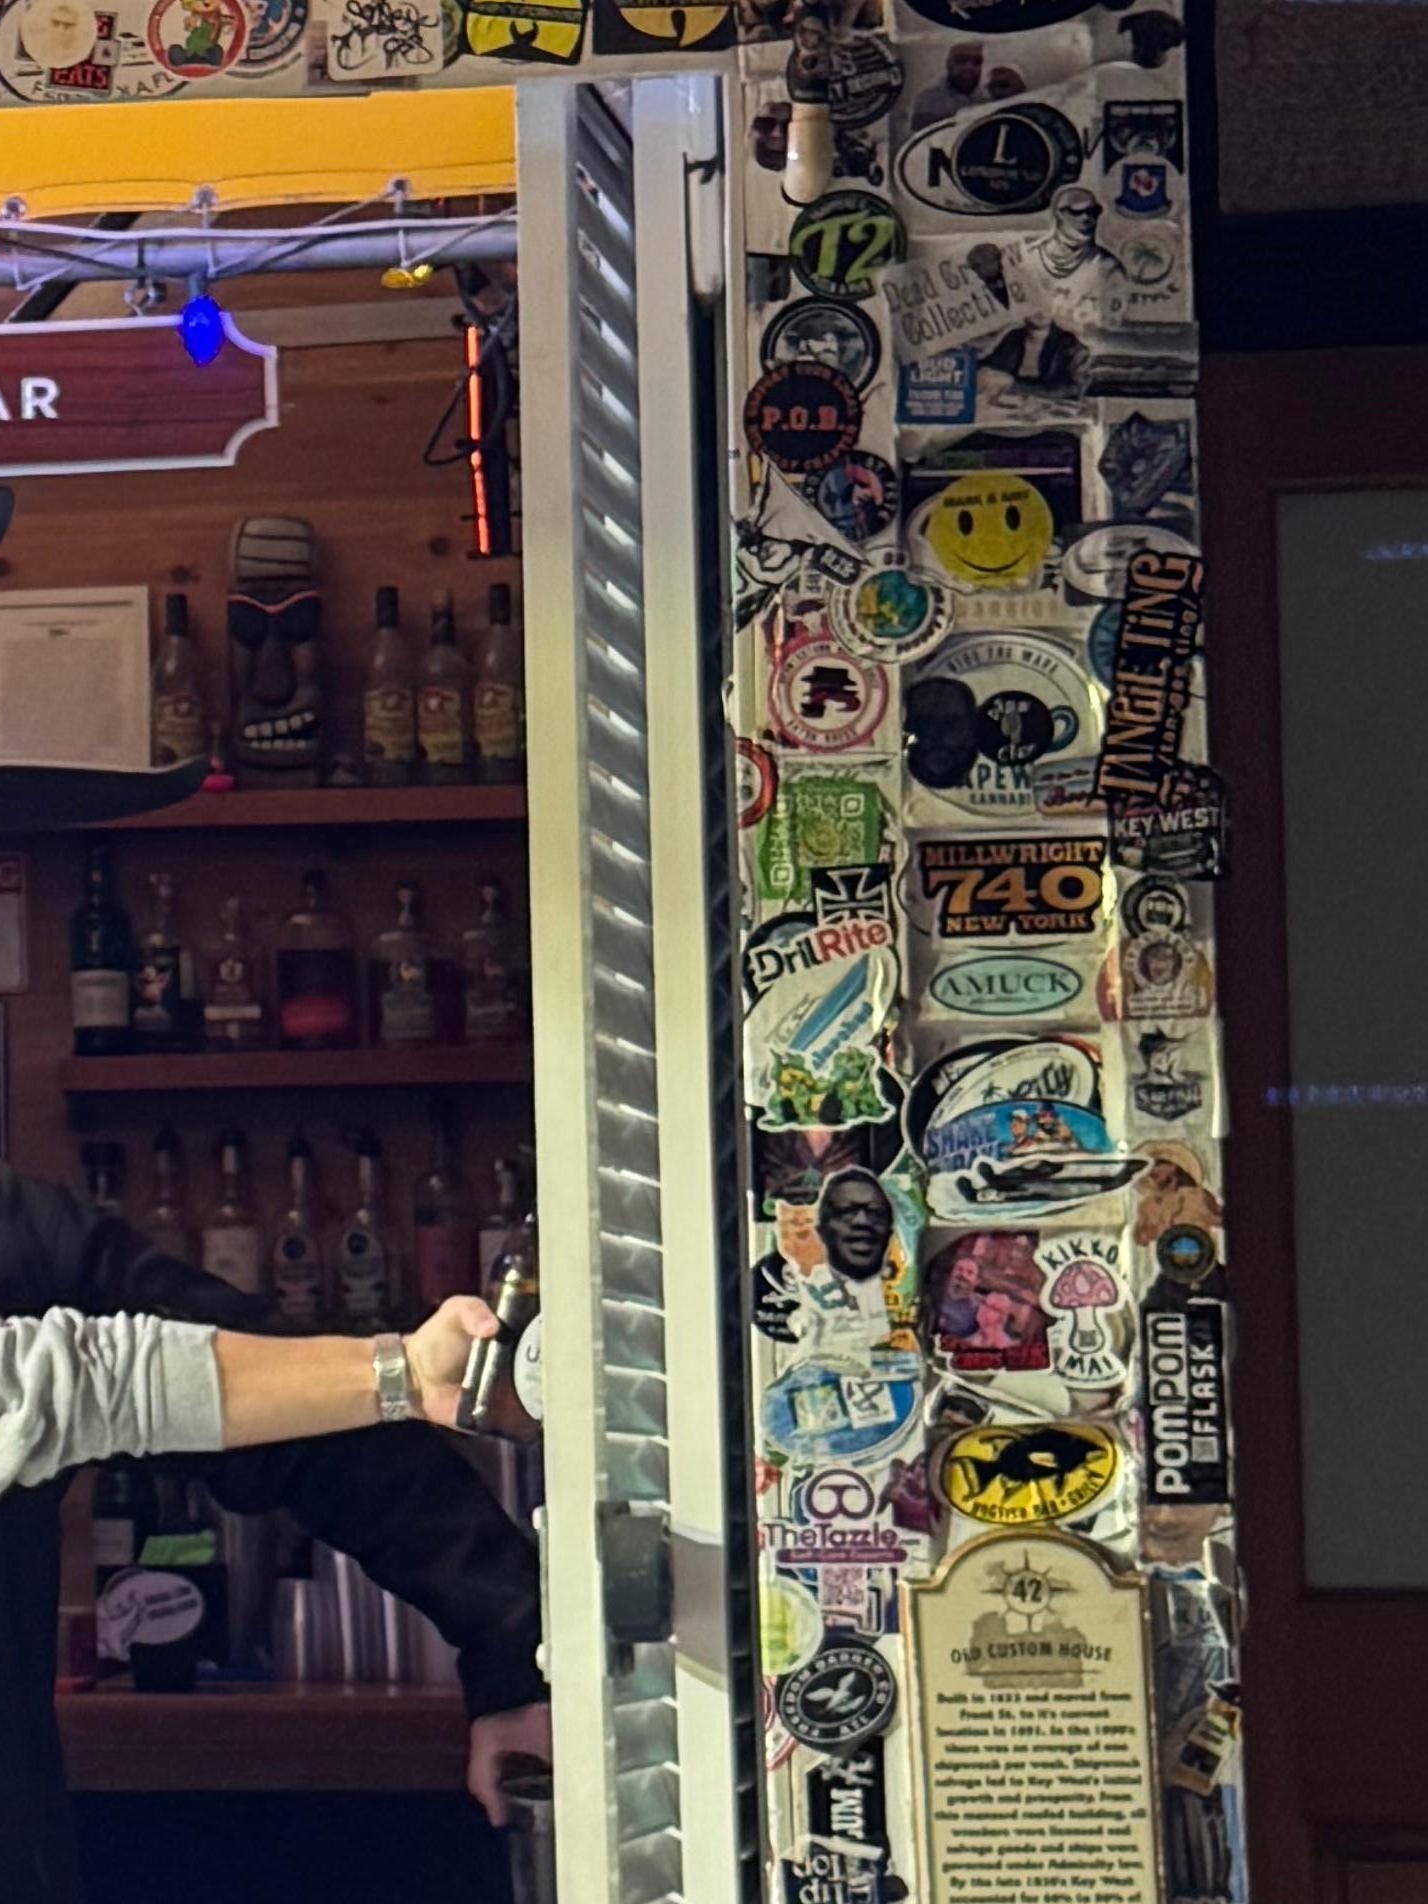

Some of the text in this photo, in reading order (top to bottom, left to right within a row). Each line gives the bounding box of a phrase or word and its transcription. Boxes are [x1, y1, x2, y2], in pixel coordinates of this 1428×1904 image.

[882, 270, 937, 314] Dead
[1113, 805, 1221, 839] KEY WEST
[922, 841, 1104, 870] MILLWRIGHT
[927, 865, 1102, 915] 740
[945, 912, 1092, 934] NEW YORK
[751, 919, 889, 989] DrilRite
[943, 963, 1072, 999] AMUCK
[1041, 1233, 1121, 1270] KIKKO
[1063, 1354, 1115, 1379] MAI
[1149, 1313, 1190, 1496] POMPOM
[1192, 1339, 1219, 1440] FLASK
[1008, 1578, 1045, 1605] 42
[950, 1641, 1113, 1665] OLD CUSTOM HOUSE
[1100, 1875, 1134, 1886] West
